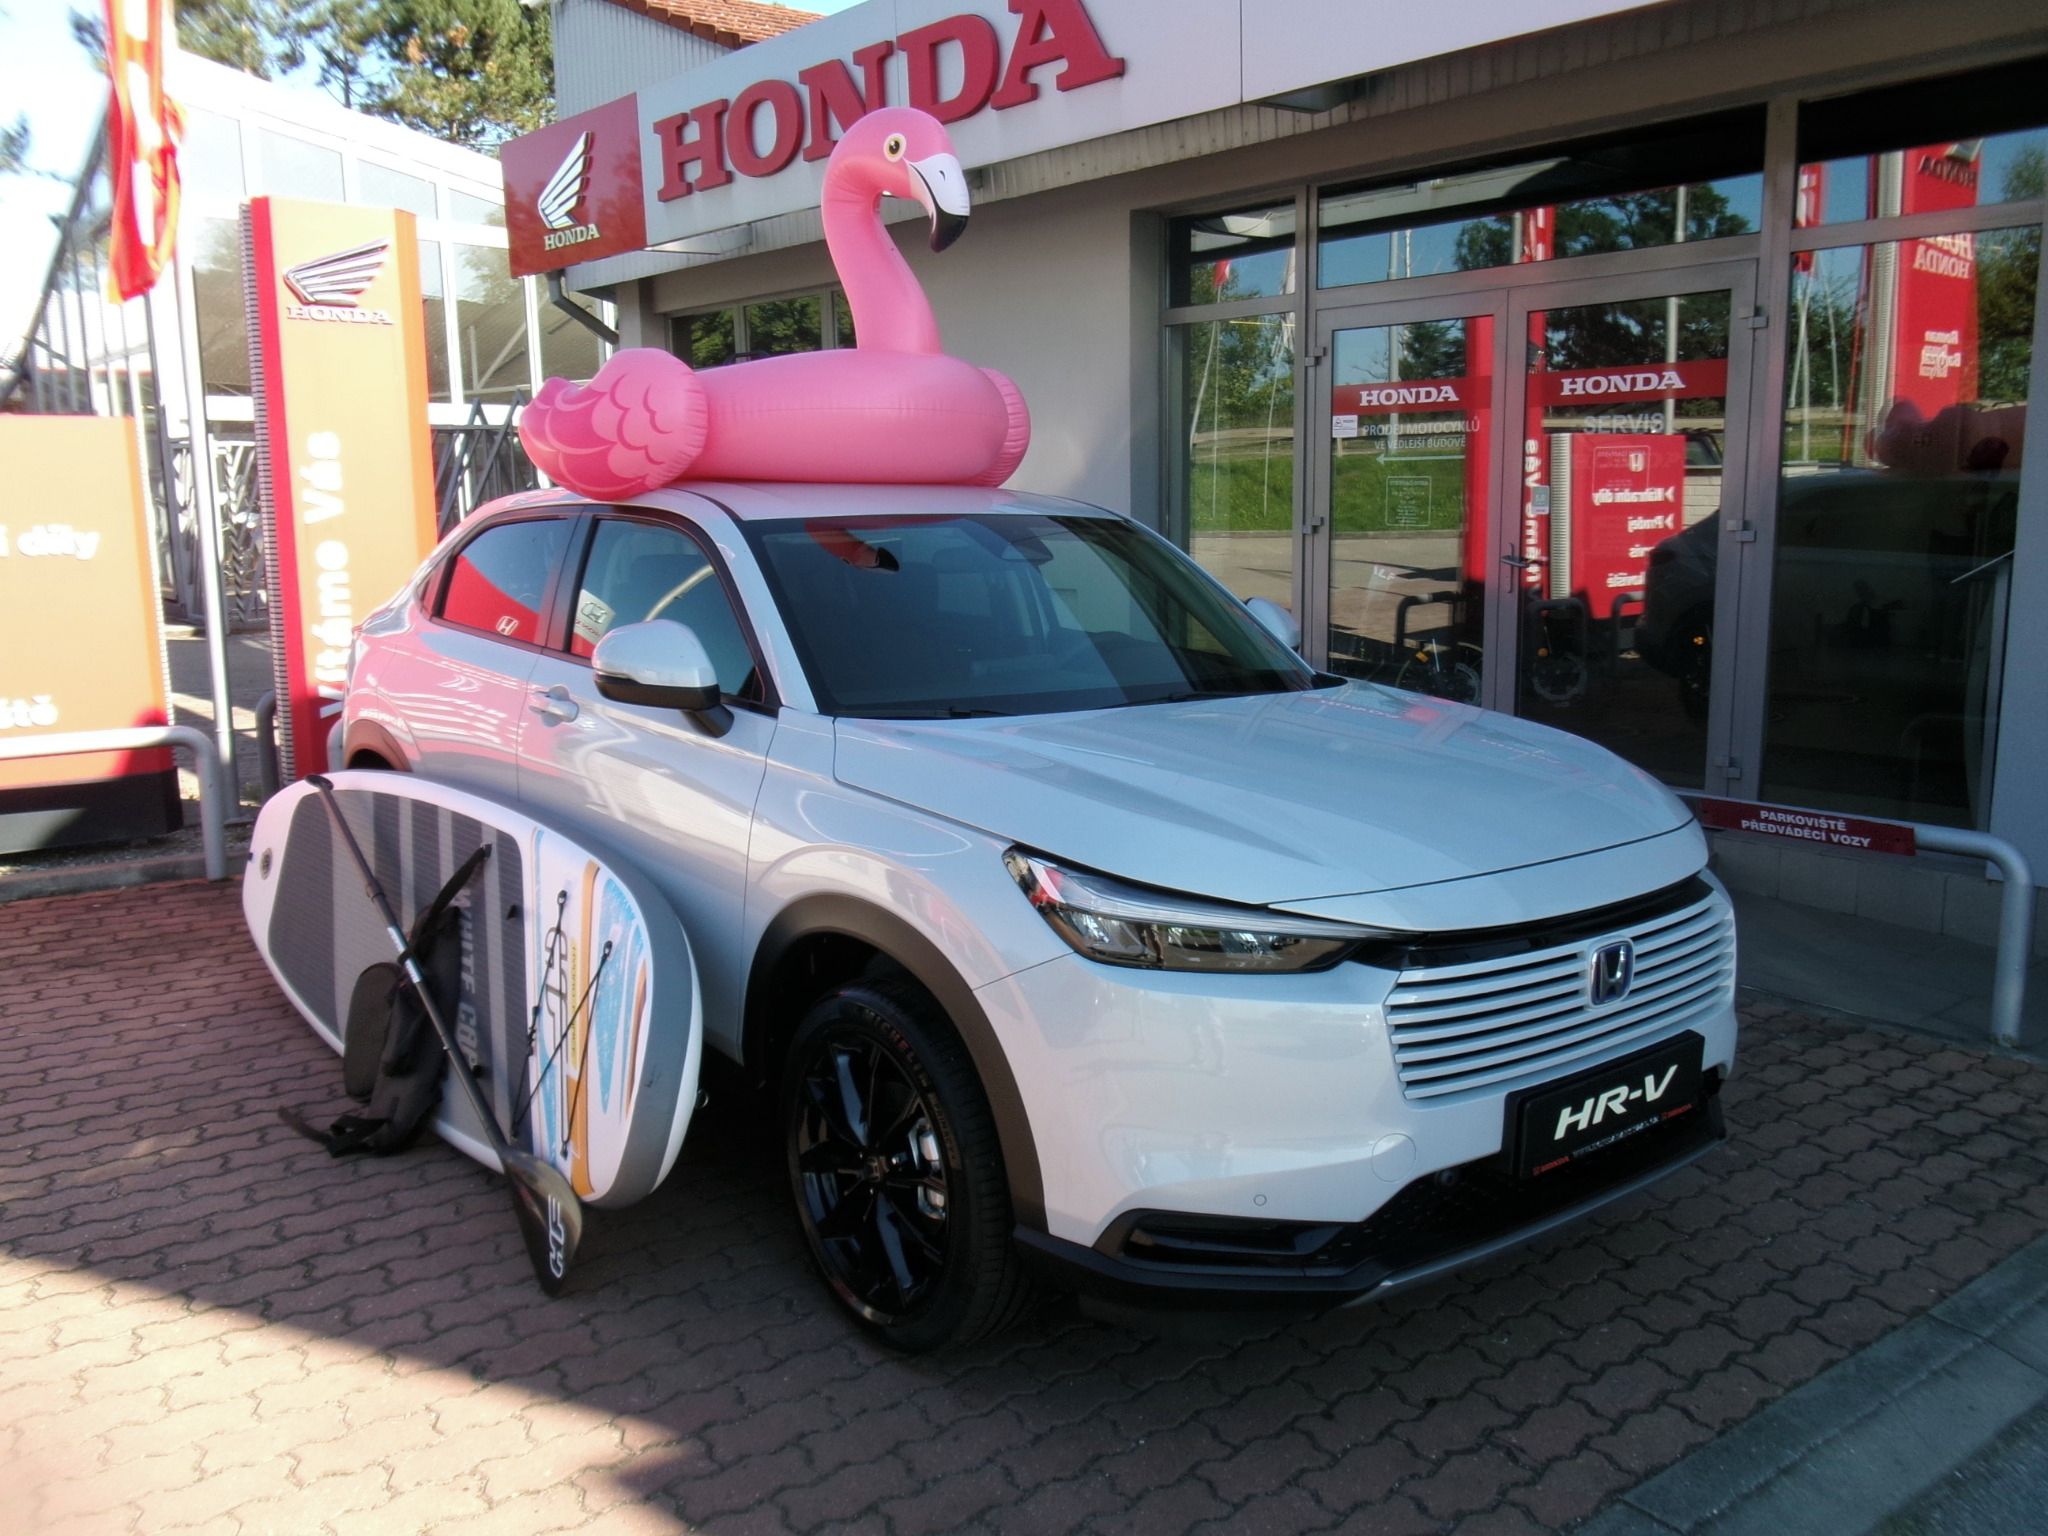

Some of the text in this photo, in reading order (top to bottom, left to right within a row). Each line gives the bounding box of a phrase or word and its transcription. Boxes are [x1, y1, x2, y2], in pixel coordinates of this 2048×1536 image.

[653, 0, 1125, 202] HONDA
[544, 223, 600, 251] HONDA
[286, 306, 393, 325] HONDA
[1560, 371, 1687, 396] HONDA
[1359, 386, 1460, 406] HONDA
[1363, 423, 1404, 436] PRODEJ
[1406, 415, 1480, 435] MOTOCYKLŮ
[1583, 412, 1666, 433] SERVIS
[1375, 439, 1385, 449] VE
[1427, 433, 1466, 448] BUDOVĚ
[1760, 810, 1847, 832] PARKOVIŠTĚ
[1741, 819, 1871, 848] PŘEDVÁDĚCÍ VOZY
[1553, 1064, 1679, 1141] HR-V
